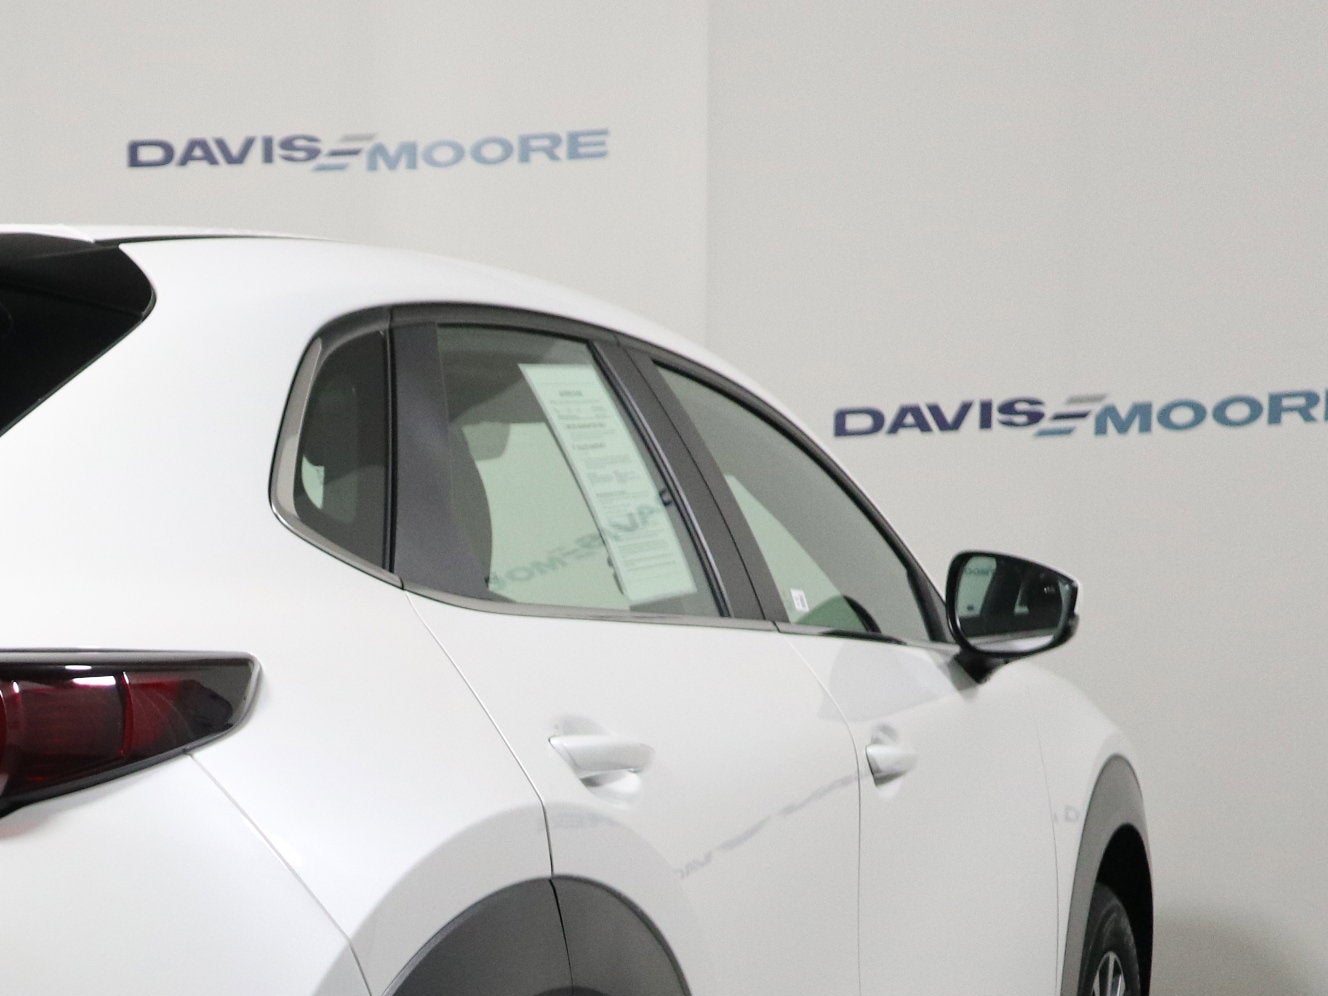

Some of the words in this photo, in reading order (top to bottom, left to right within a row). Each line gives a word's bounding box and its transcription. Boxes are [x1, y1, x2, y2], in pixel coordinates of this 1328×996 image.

[127, 134, 320, 168] DAVIS
[366, 128, 609, 171] MOORE
[834, 397, 1045, 438] DAVIS
[1094, 389, 1328, 435] MOOR
